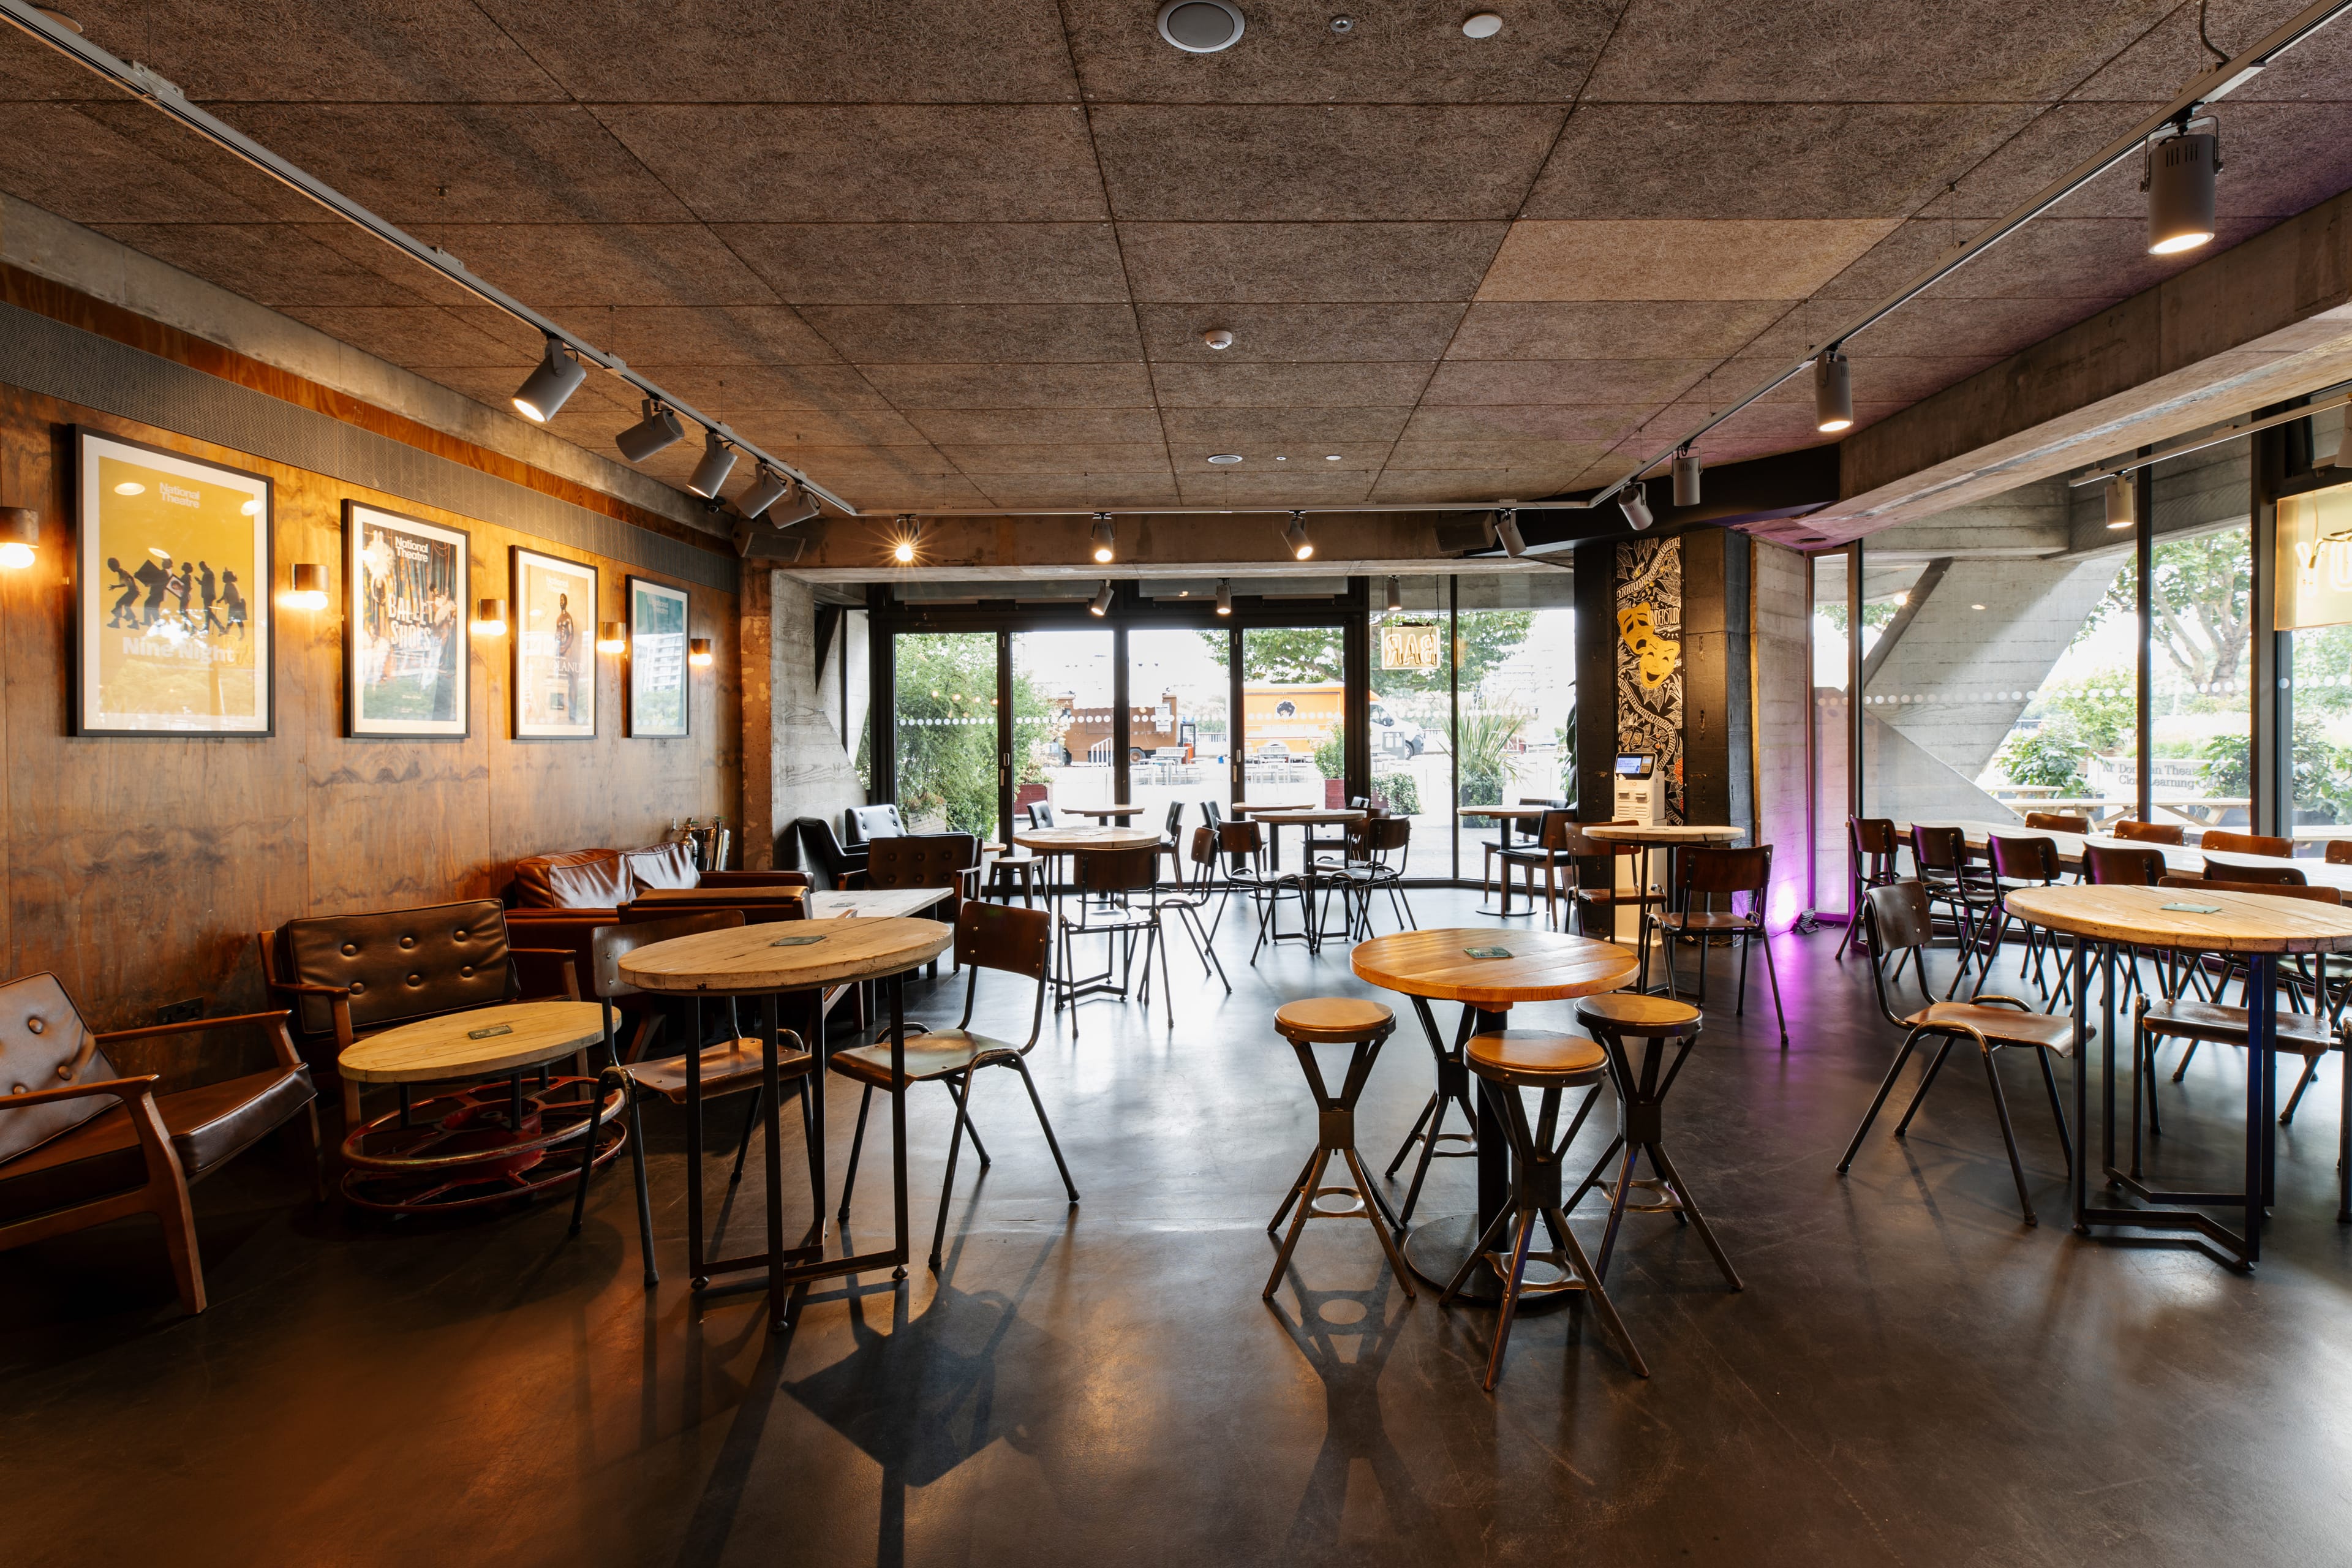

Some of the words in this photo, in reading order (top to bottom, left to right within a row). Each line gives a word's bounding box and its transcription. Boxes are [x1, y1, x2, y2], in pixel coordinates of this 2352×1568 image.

[159, 481, 200, 500] National
[160, 491, 200, 508] Theatre
[395, 536, 428, 553] National
[395, 546, 428, 562] Theatre
[388, 593, 434, 625] BALLET
[1648, 607, 1681, 625] UNDERSTUDY
[390, 620, 431, 650] SHOES
[123, 636, 173, 657] Nine
[178, 638, 235, 664] Night
[2119, 775, 2136, 785] Clo
[2150, 778, 2195, 790] earning
